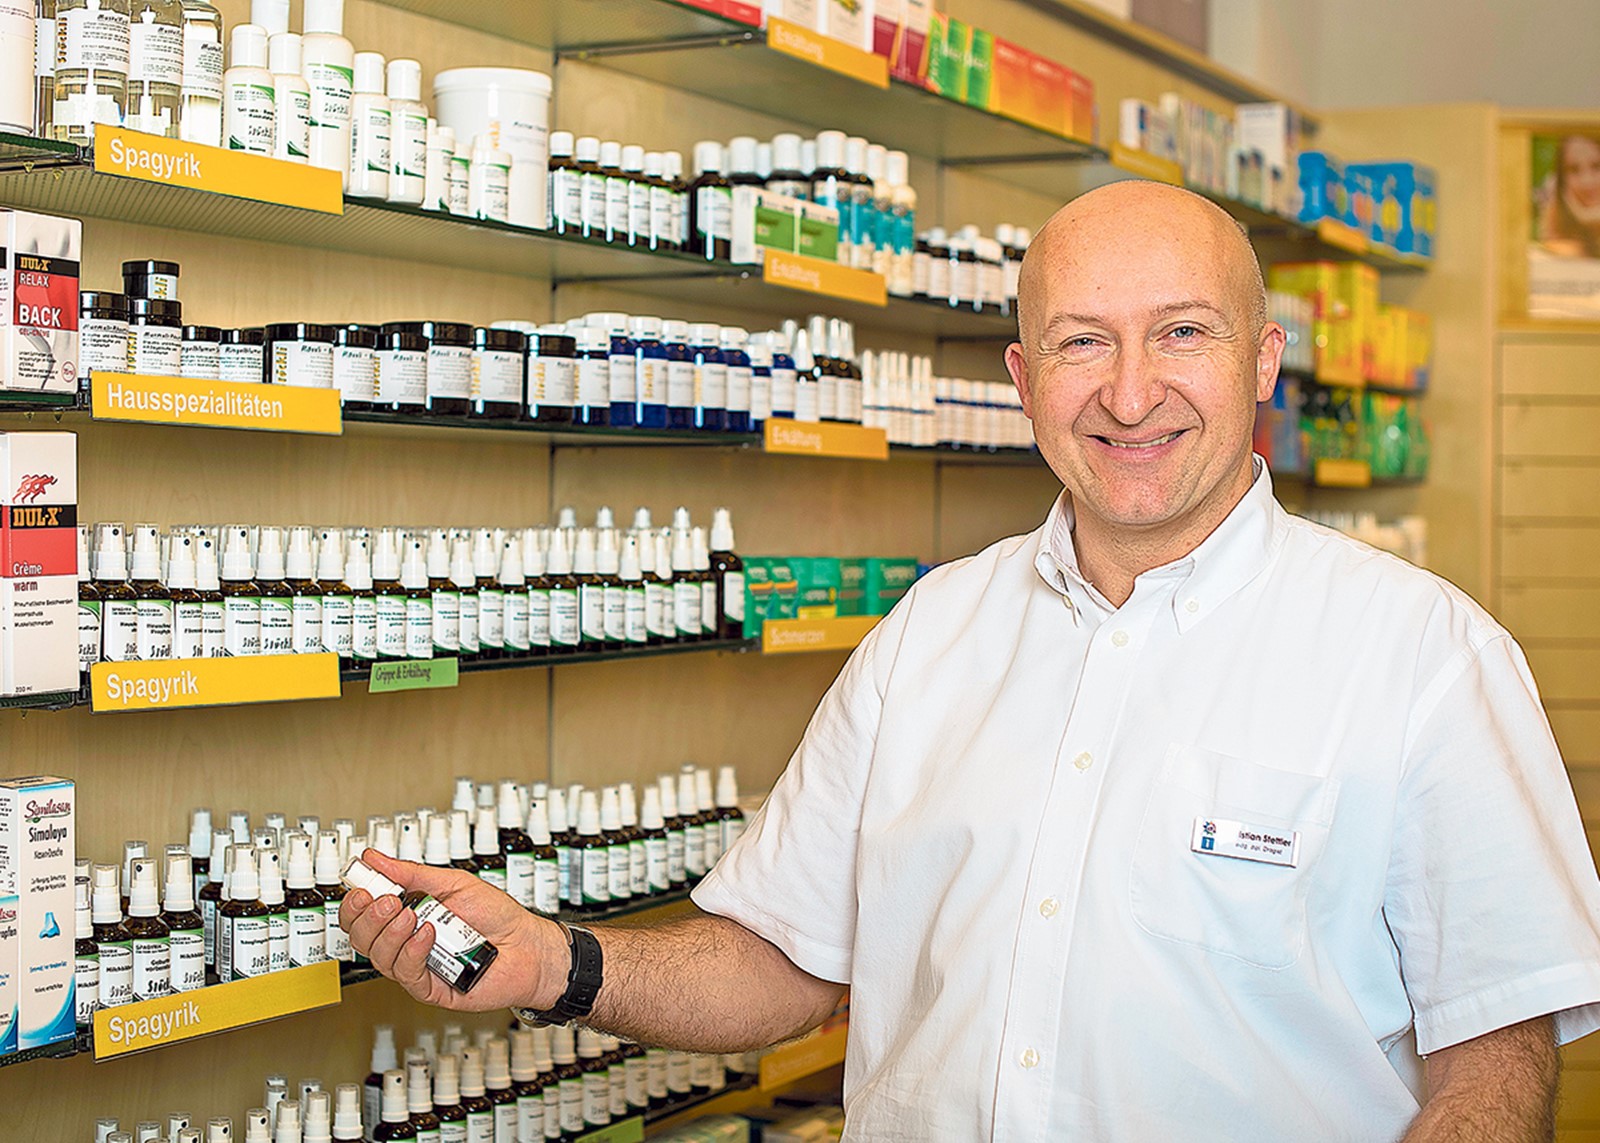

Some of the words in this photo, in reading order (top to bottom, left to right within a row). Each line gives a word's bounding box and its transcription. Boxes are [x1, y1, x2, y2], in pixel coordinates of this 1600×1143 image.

[110, 138, 202, 179] Spagyrik
[19, 272, 49, 288] RELAX
[19, 303, 62, 328] BACK
[107, 383, 283, 418] Hausspezialitäten
[13, 507, 59, 526] DUL-X
[13, 561, 42, 576] Crème
[13, 581, 38, 592] warm
[107, 670, 199, 704] Spagyrik
[109, 1001, 201, 1046] Spagyrik
